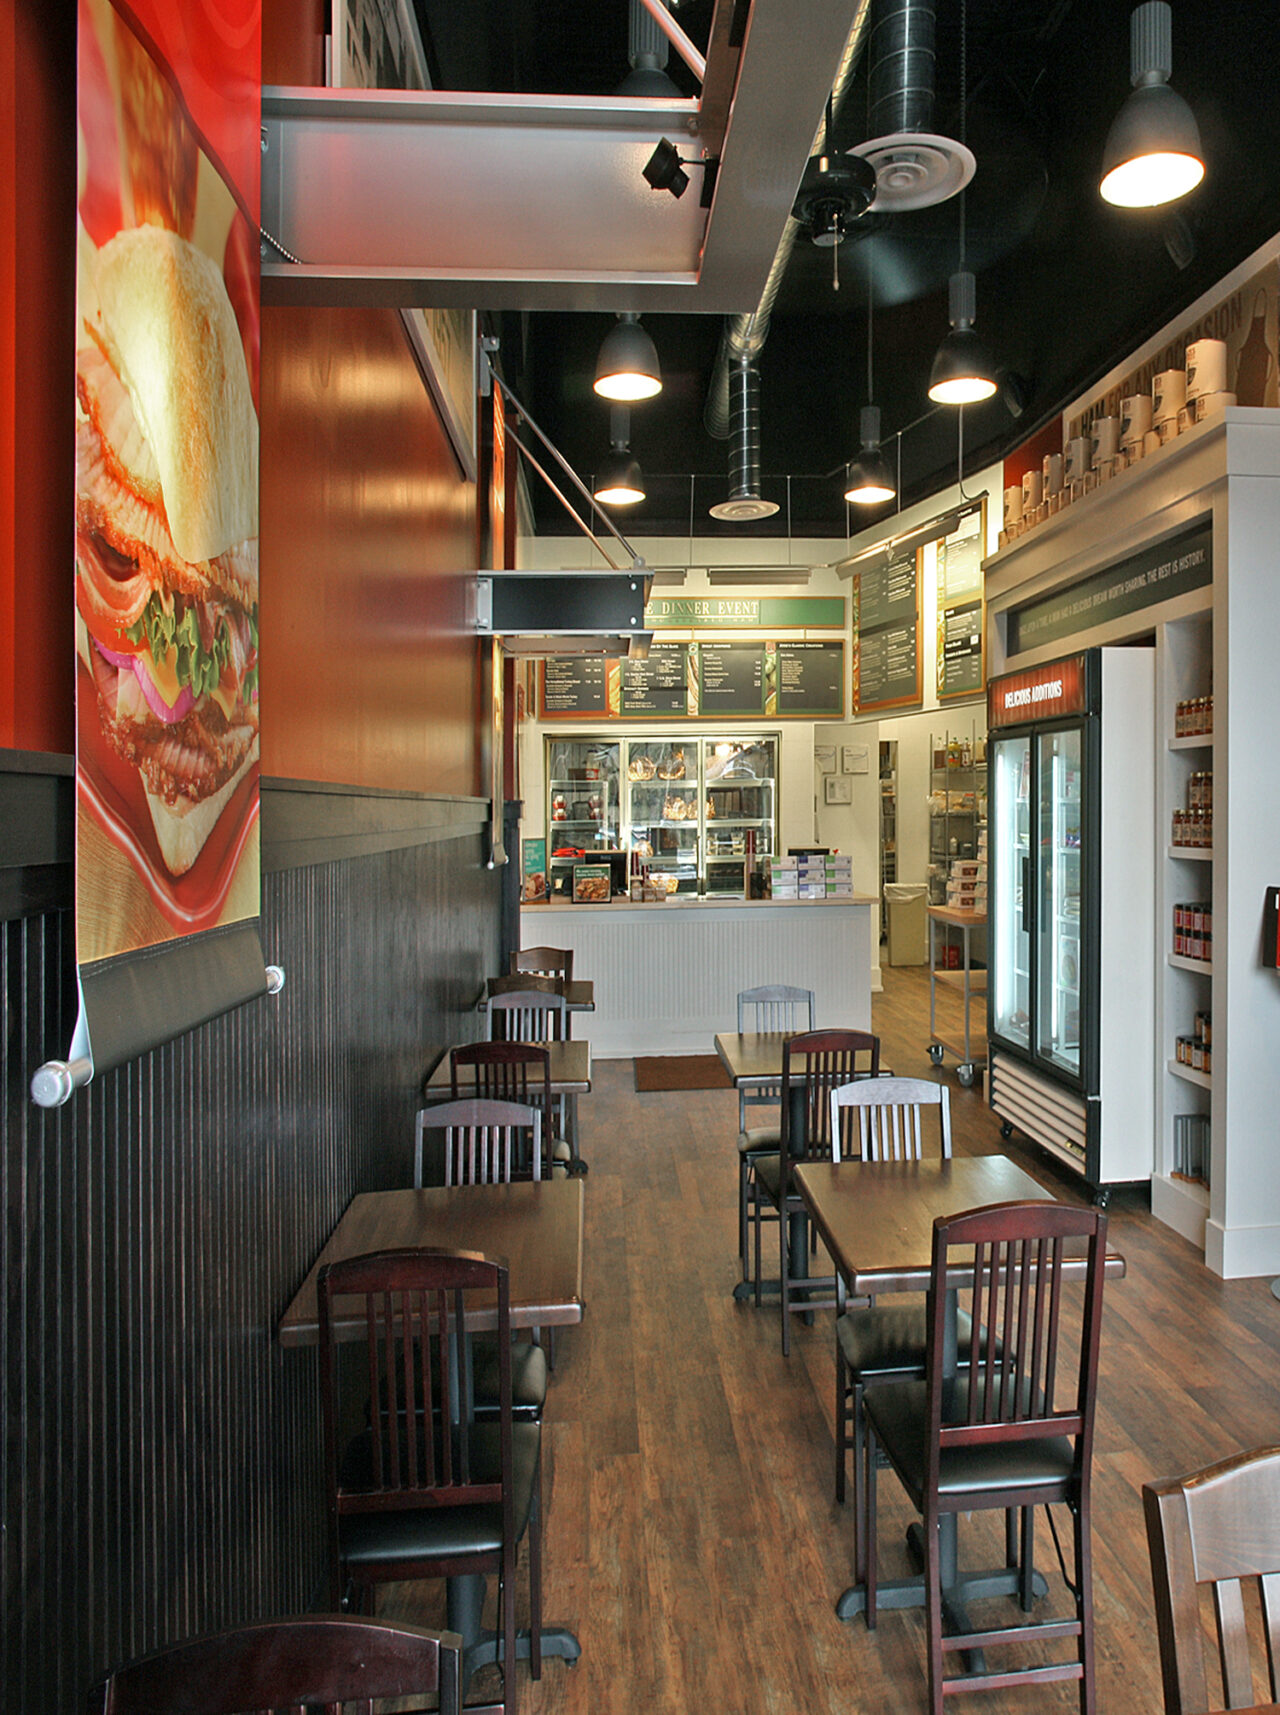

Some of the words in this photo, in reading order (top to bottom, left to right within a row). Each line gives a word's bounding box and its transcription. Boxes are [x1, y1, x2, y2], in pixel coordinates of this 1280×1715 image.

[1158, 562, 1172, 580] REST
[1172, 560, 1178, 575] IS
[662, 601, 710, 615] DINNER
[718, 600, 759, 615] EVENT
[1004, 687, 1031, 709] DELICIOUS
[1031, 679, 1063, 703] ADDITIONS
